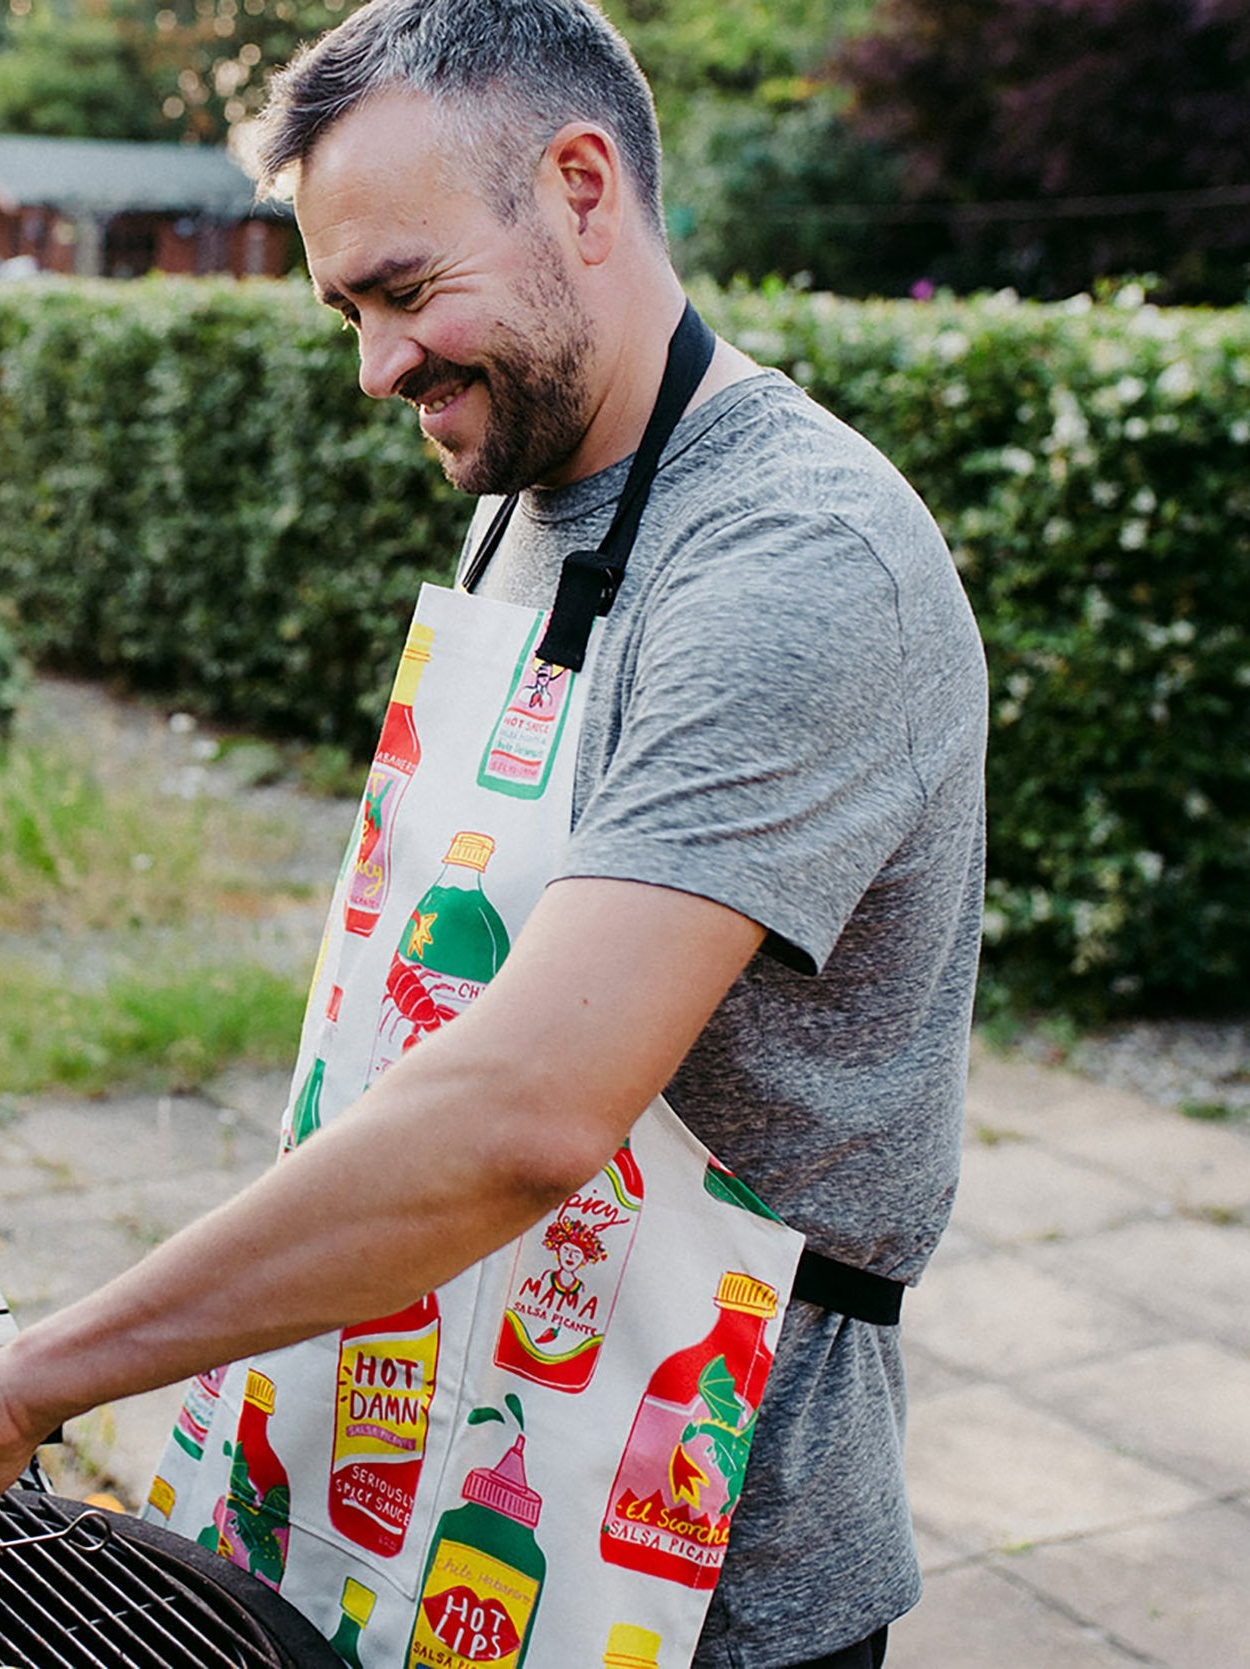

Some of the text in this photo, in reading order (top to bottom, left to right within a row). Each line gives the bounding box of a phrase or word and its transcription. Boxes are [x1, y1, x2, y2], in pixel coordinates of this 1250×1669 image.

[557, 1189, 630, 1236] picy
[513, 1301, 597, 1337] SALSA PICANTE
[519, 1276, 598, 1320] MAMA
[355, 1350, 418, 1389] HOT
[350, 1389, 419, 1426] DAMN
[335, 1478, 411, 1527] SPICY SAUCE
[352, 1465, 415, 1510] SERIOUSLY
[609, 1519, 721, 1565] SALSA PICAN
[445, 1594, 506, 1634] HOT
[413, 1640, 452, 1669] SALSA
[434, 1613, 501, 1660] LIPS
